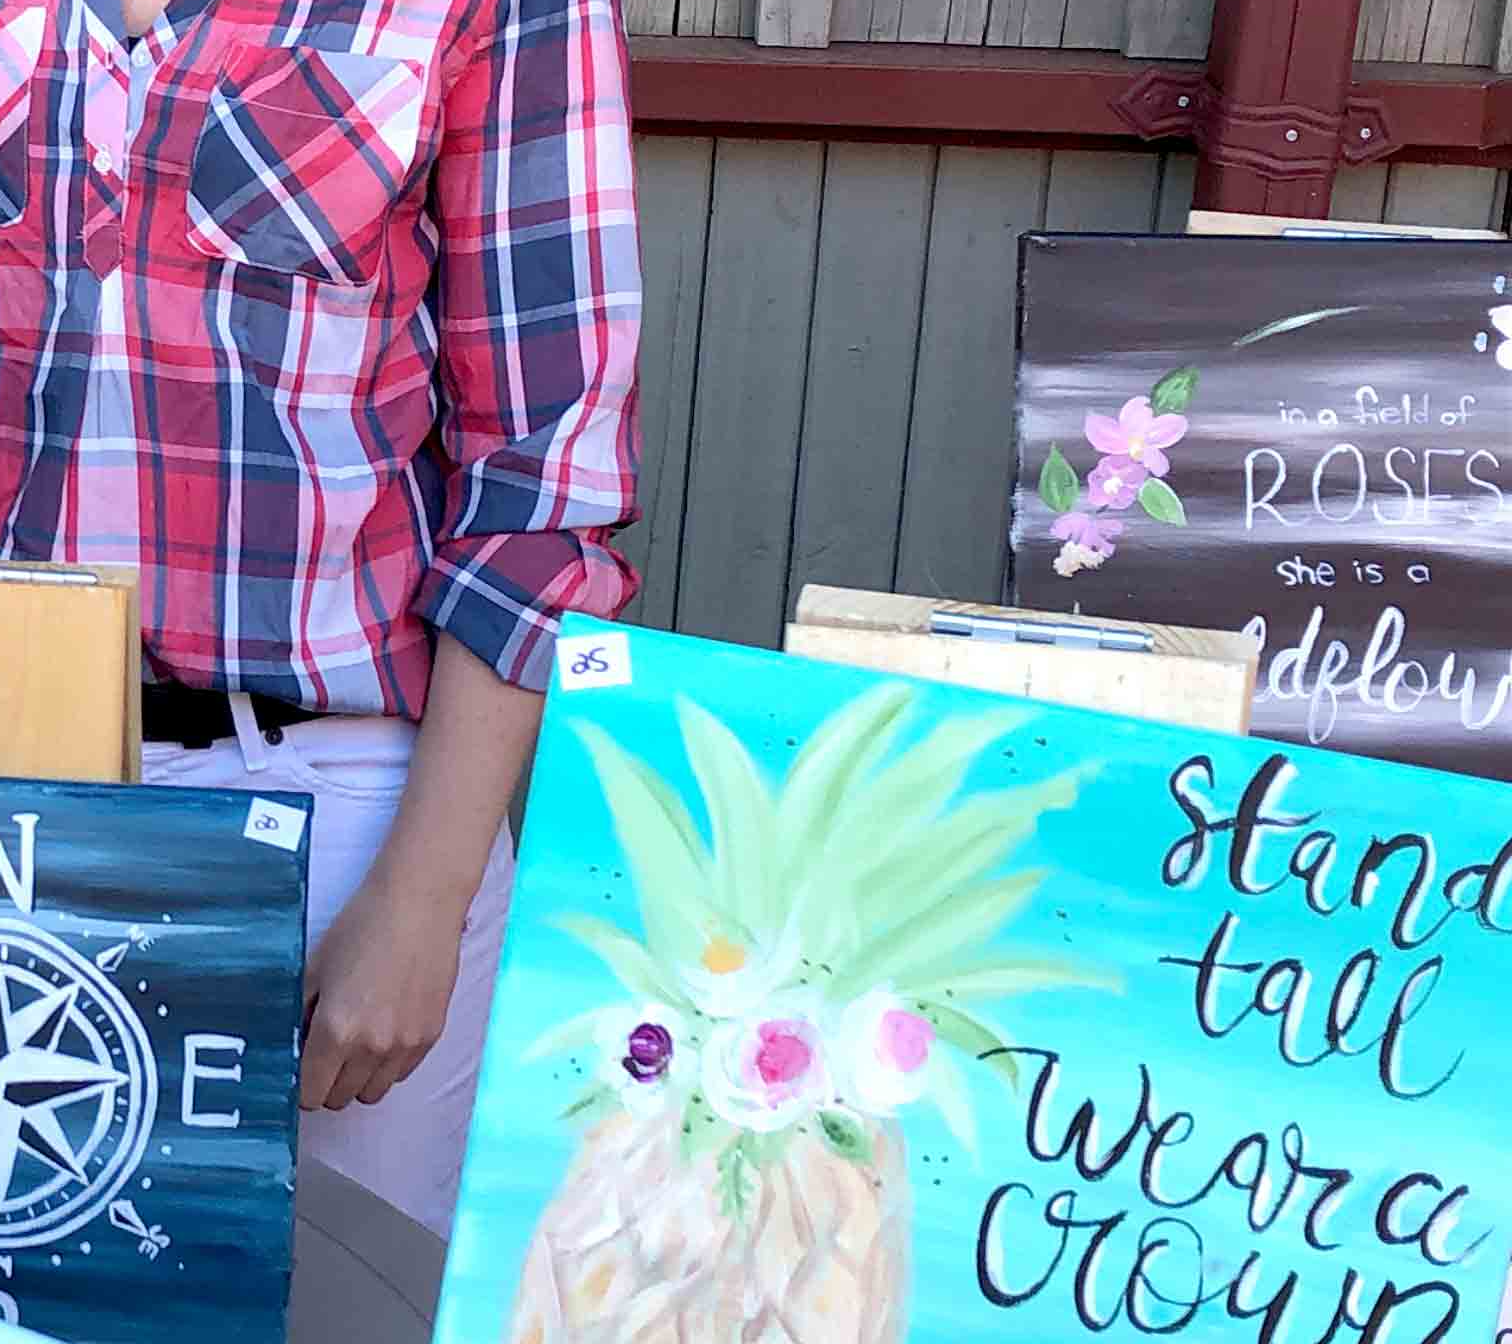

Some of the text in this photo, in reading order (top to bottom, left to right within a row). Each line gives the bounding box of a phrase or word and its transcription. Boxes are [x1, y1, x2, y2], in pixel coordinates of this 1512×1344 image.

[1278, 385, 1476, 427] in a field of
[1243, 442, 1512, 531] ROSES
[1276, 555, 1432, 588] she is a
[570, 646, 610, 675] 25
[1159, 911, 1465, 1099] tall
[180, 1033, 247, 1129] E
